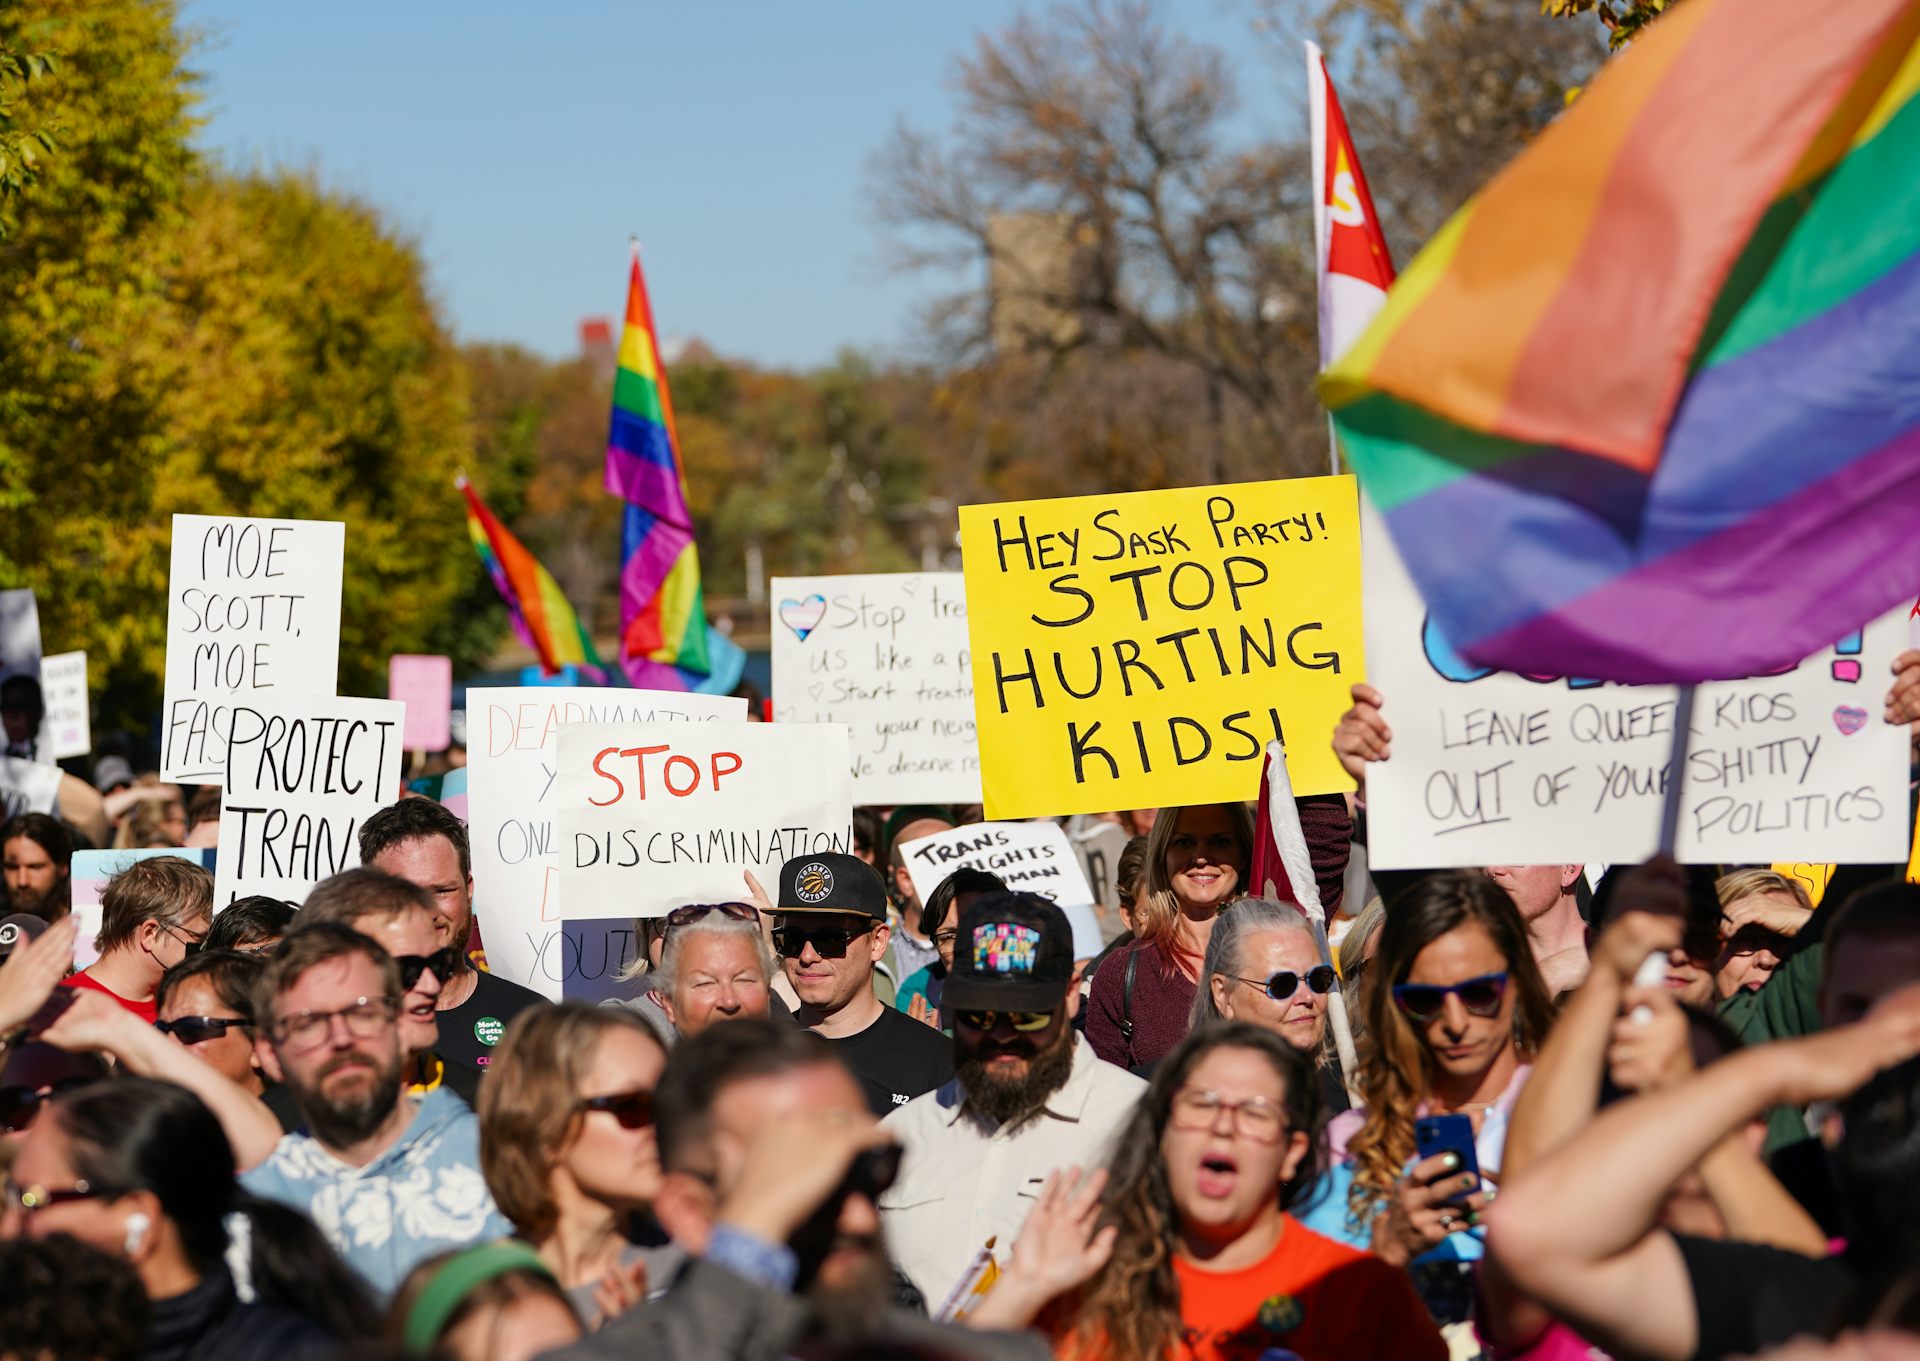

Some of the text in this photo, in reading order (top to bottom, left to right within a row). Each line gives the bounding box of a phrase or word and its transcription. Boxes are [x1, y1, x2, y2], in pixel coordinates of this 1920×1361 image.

[202, 523, 294, 581] MOE
[181, 588, 305, 638] SCOTT,
[831, 592, 906, 640] Stop
[1031, 556, 1269, 628] STOP
[193, 642, 275, 691] MOE
[875, 642, 914, 671] like
[933, 655, 947, 665] a
[992, 618, 1341, 714] HURTING
[828, 678, 896, 704] Start
[873, 715, 923, 754] your
[1440, 708, 1550, 749] LEAVE
[1569, 701, 1704, 745] QUEE
[1714, 692, 1797, 730] KIDS
[224, 707, 396, 803] PROTECT
[588, 744, 743, 807] STOP
[887, 752, 951, 776] deserve
[1425, 760, 1515, 824] OUT
[1533, 765, 1577, 807] OF
[1688, 734, 1821, 787] SHITTY
[1693, 785, 1884, 843] POLITICS
[225, 806, 356, 882] TRAN
[575, 824, 851, 869] DISCRIMINATION
[914, 830, 1010, 866] TRANS
[797, 886, 830, 901] RAPTORS
[799, 864, 831, 880] TORONTO
